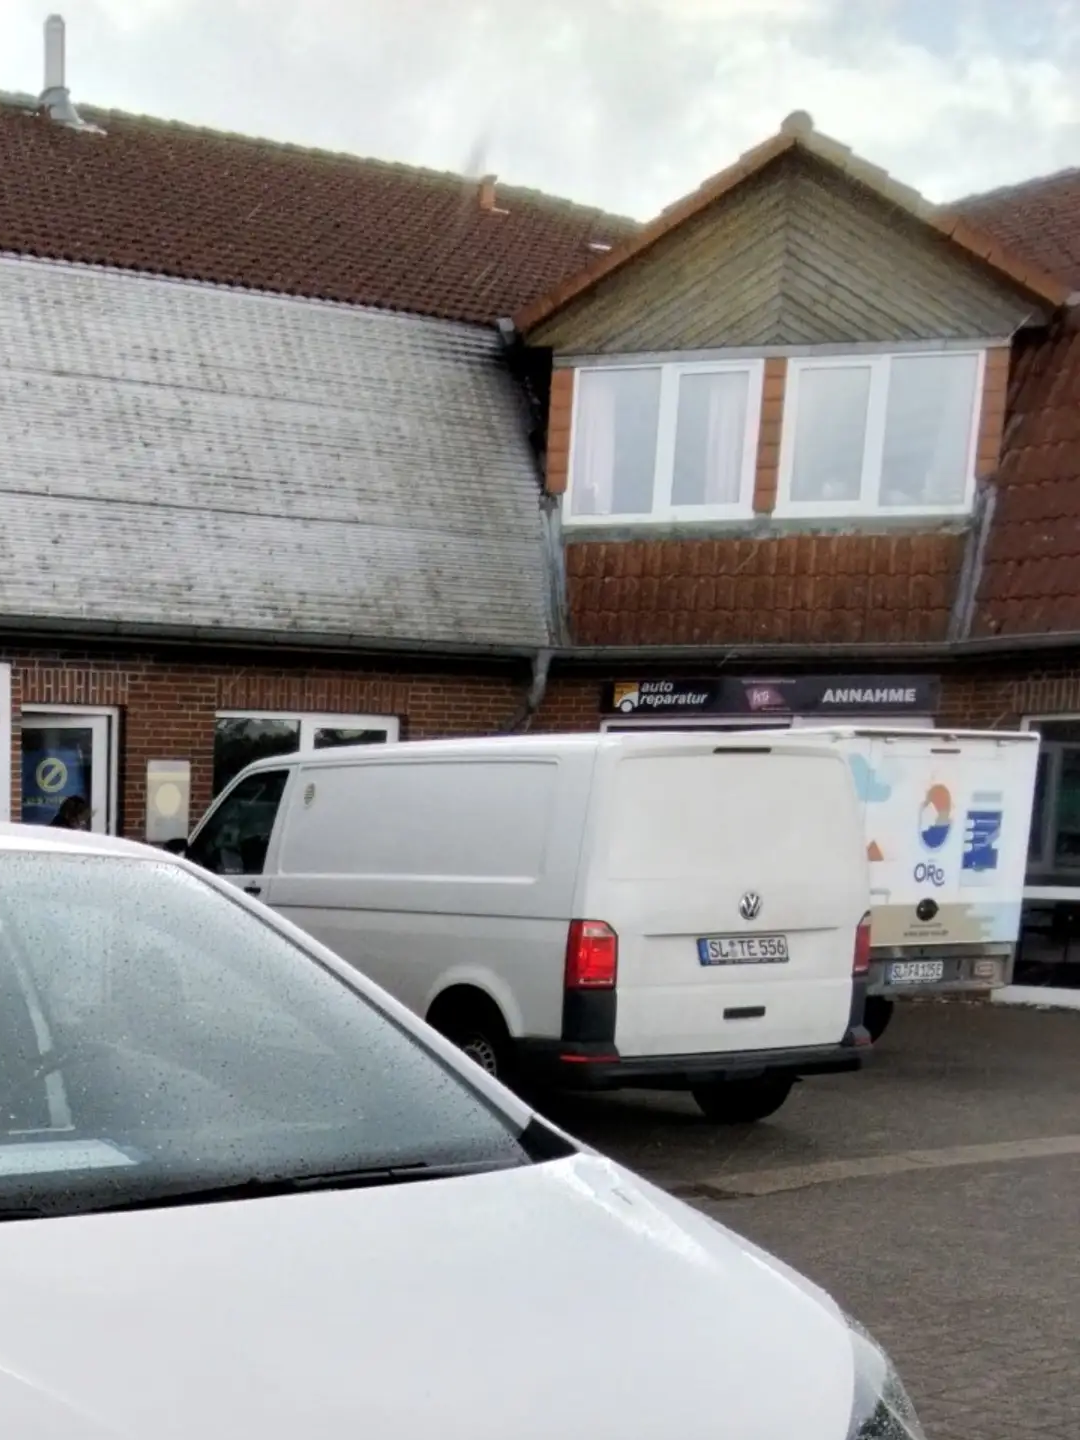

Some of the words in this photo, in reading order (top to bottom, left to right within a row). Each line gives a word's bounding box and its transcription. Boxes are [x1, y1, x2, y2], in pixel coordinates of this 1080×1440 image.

[640, 680, 674, 693] auto
[639, 691, 708, 707] reparatur
[822, 687, 917, 703] ANNAHME
[759, 938, 786, 956] 556
